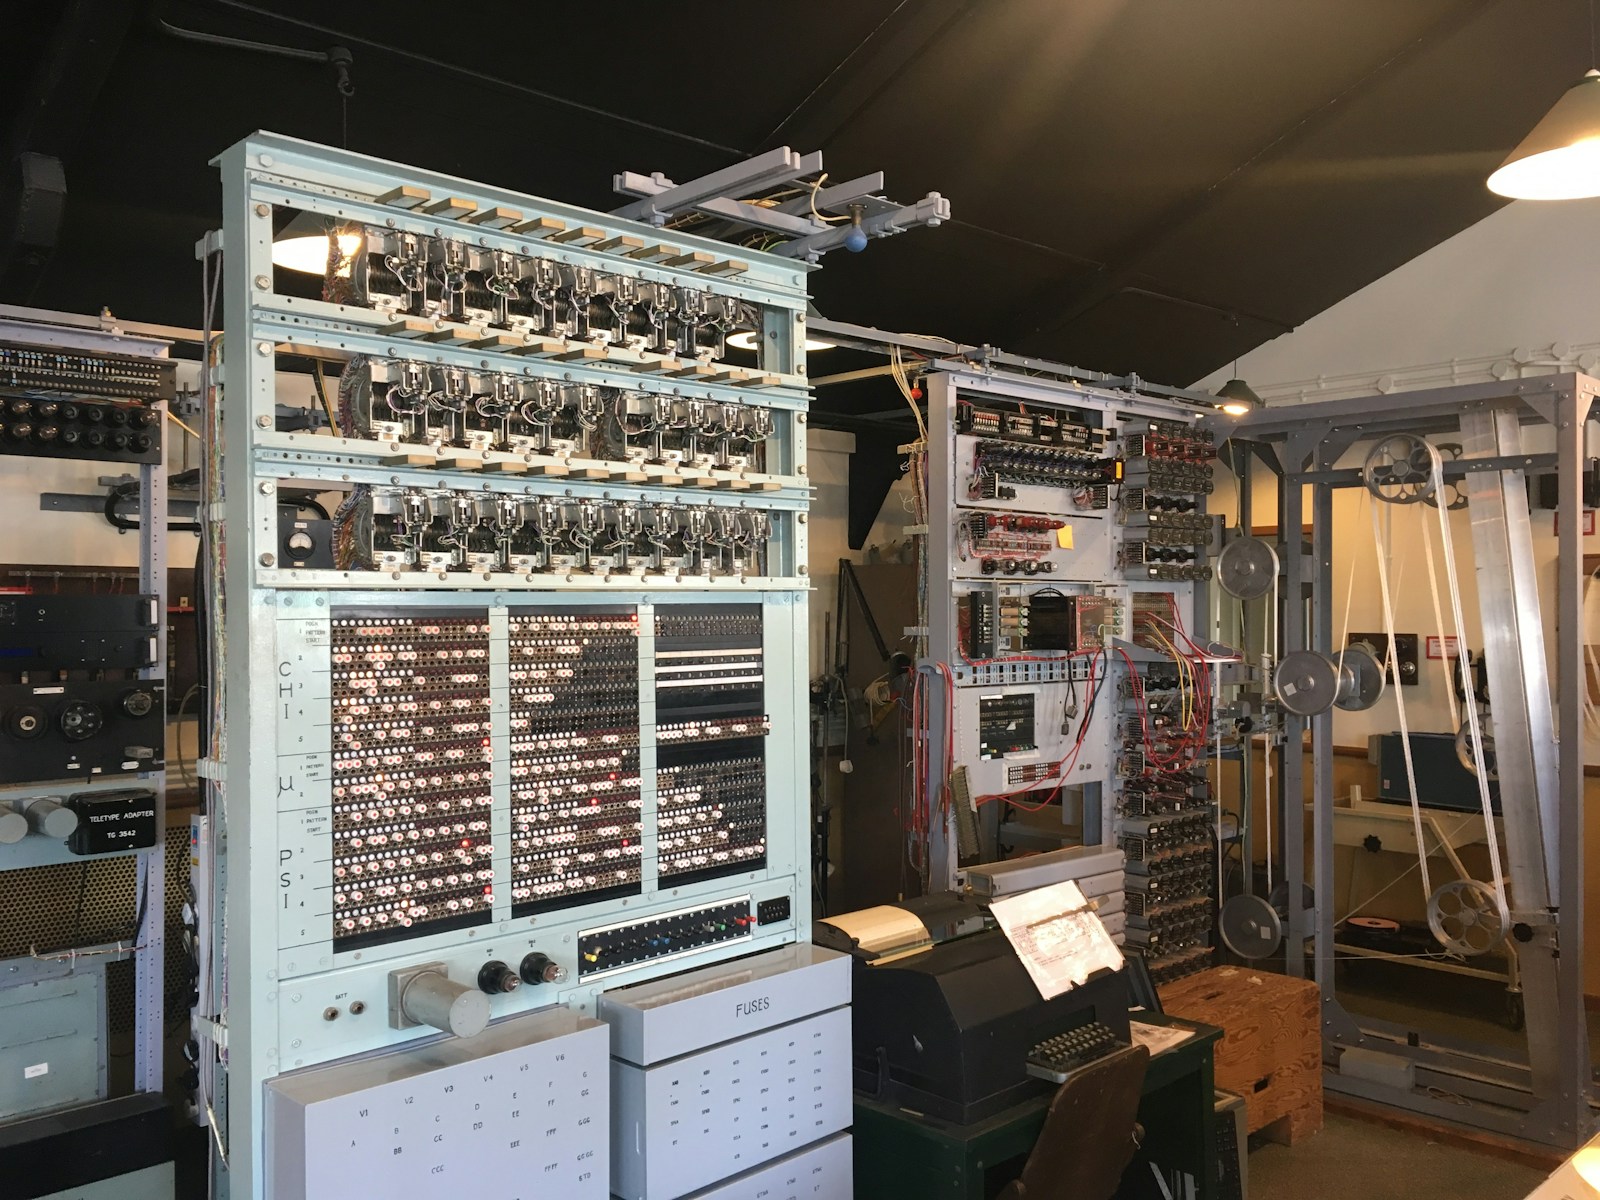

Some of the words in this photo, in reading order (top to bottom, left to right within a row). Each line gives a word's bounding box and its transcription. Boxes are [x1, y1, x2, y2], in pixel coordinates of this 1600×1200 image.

[90, 814, 119, 822] TELETYPE
[124, 810, 153, 818] ADAPTER
[280, 850, 293, 908] PSI
[737, 997, 769, 1017] FUSES
[555, 1053, 565, 1062] V6
[519, 1063, 529, 1072] V5
[483, 1074, 494, 1083] V4
[443, 1084, 454, 1094] V3
[404, 1096, 414, 1105] V2
[359, 1108, 369, 1118] V1
